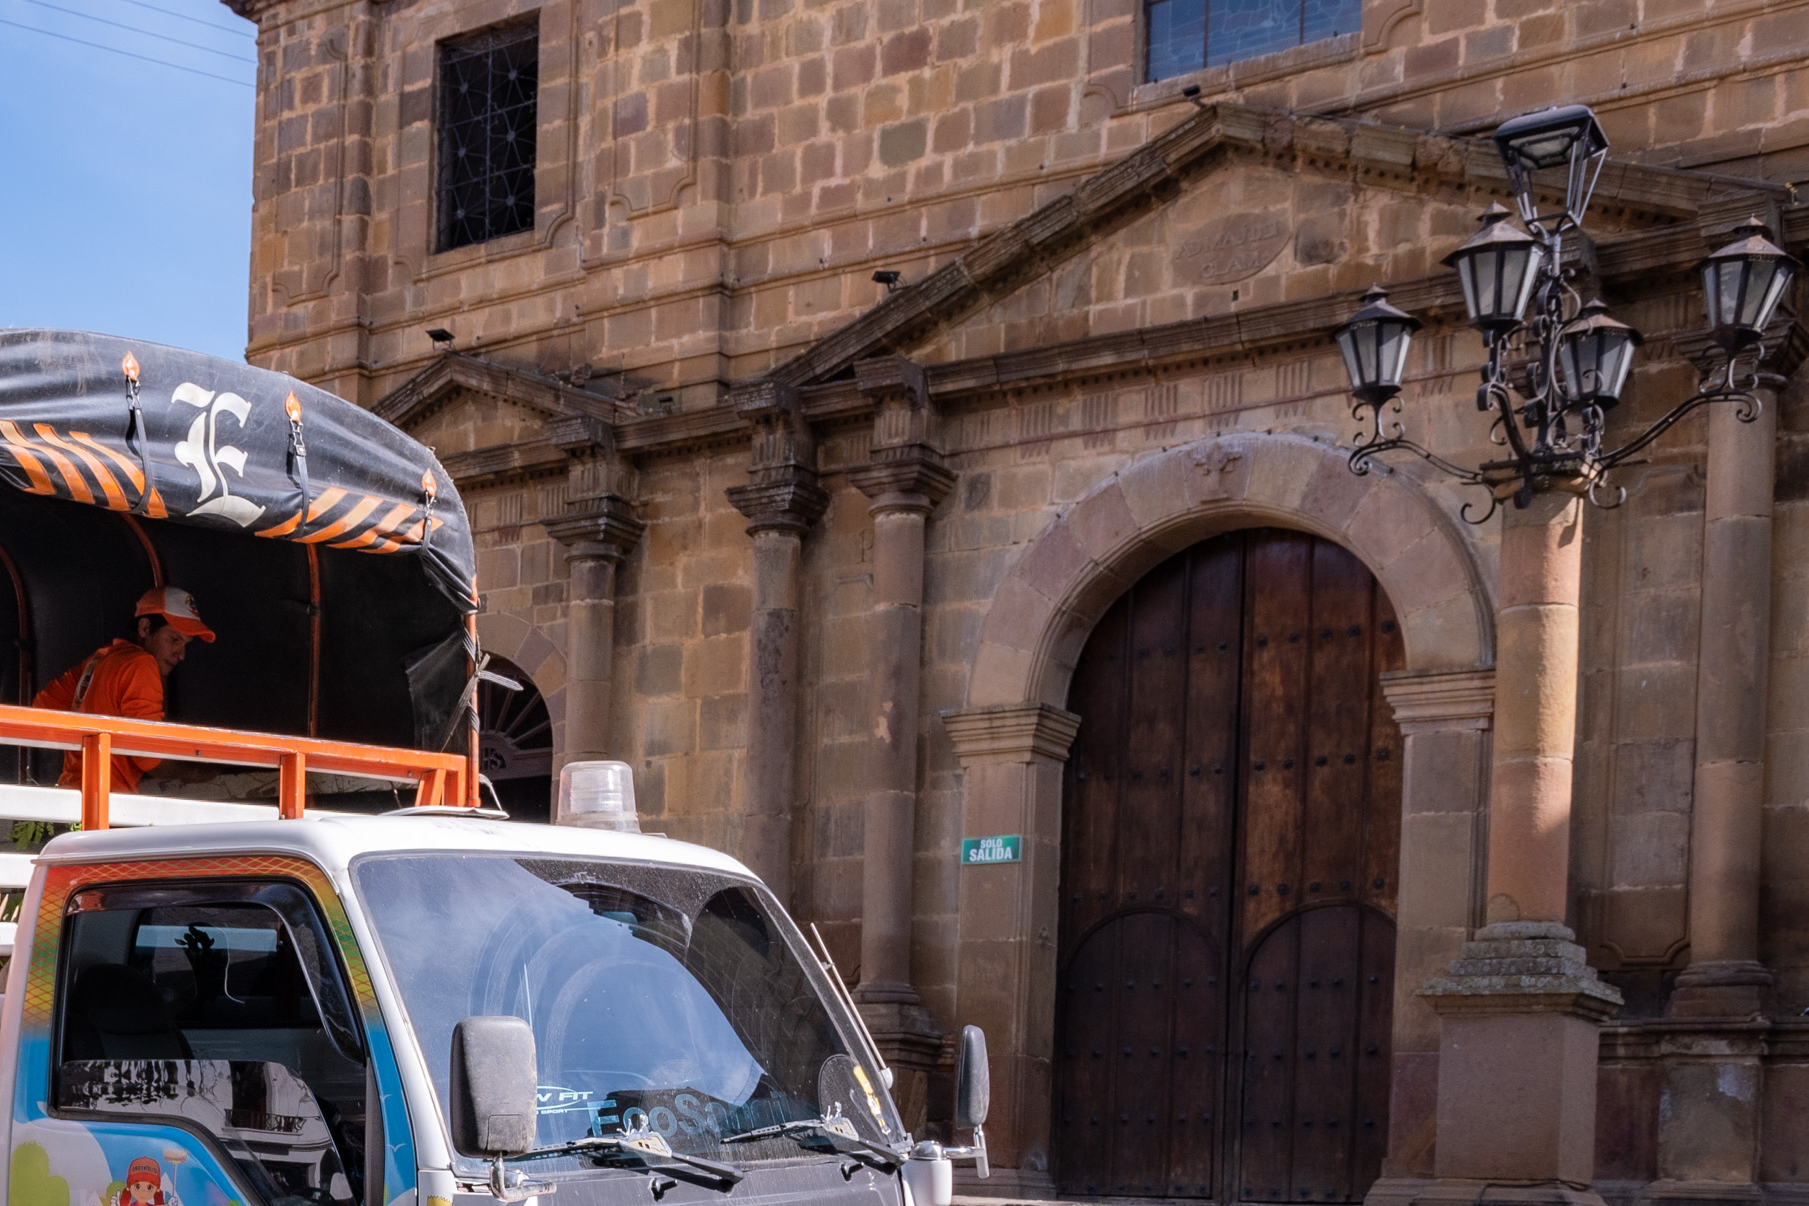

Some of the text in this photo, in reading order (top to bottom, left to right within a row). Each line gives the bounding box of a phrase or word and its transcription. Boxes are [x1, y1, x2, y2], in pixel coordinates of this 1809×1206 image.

[980, 838, 1003, 849] SOLO
[969, 847, 1013, 861] SALIDA
[559, 1091, 593, 1101] FIT
